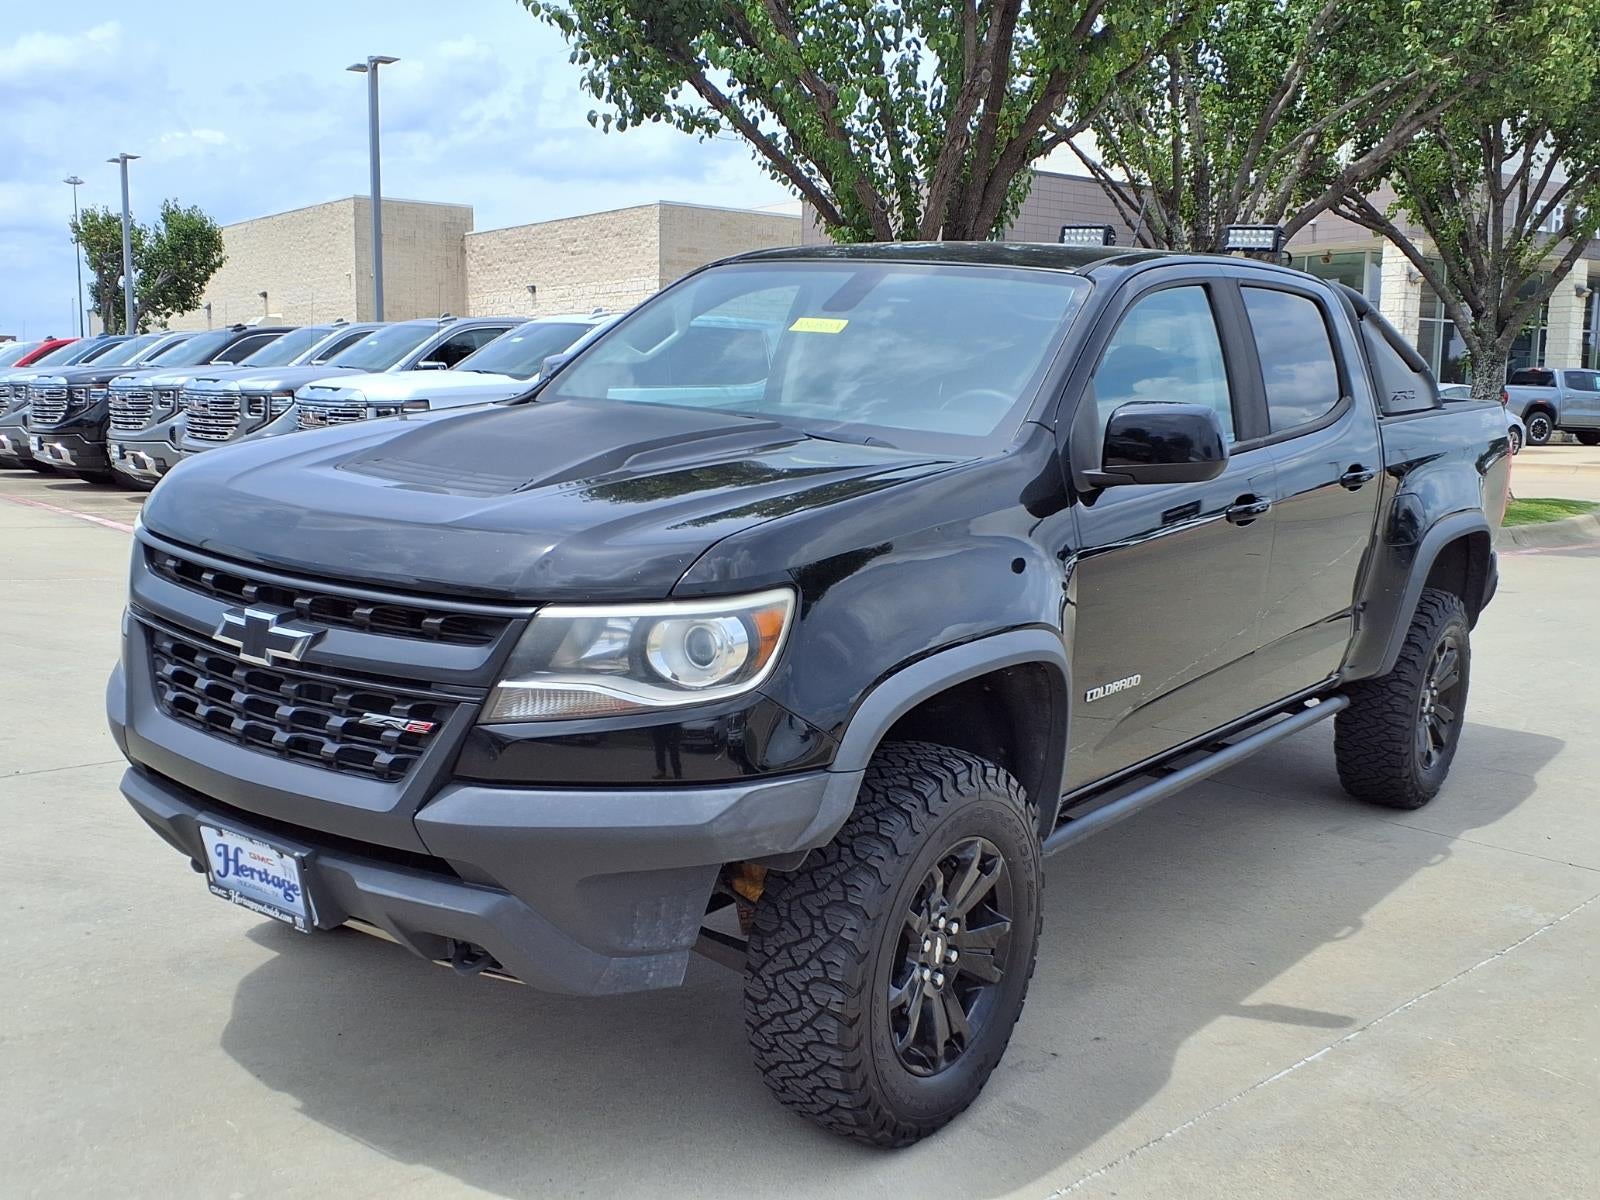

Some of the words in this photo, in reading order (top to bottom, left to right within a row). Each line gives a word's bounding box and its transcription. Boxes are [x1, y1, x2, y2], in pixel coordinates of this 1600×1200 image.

[1084, 674, 1142, 703] COLORADO
[358, 712, 436, 735] ZR2
[248, 851, 276, 867] GMC
[214, 842, 301, 903] Heritage
